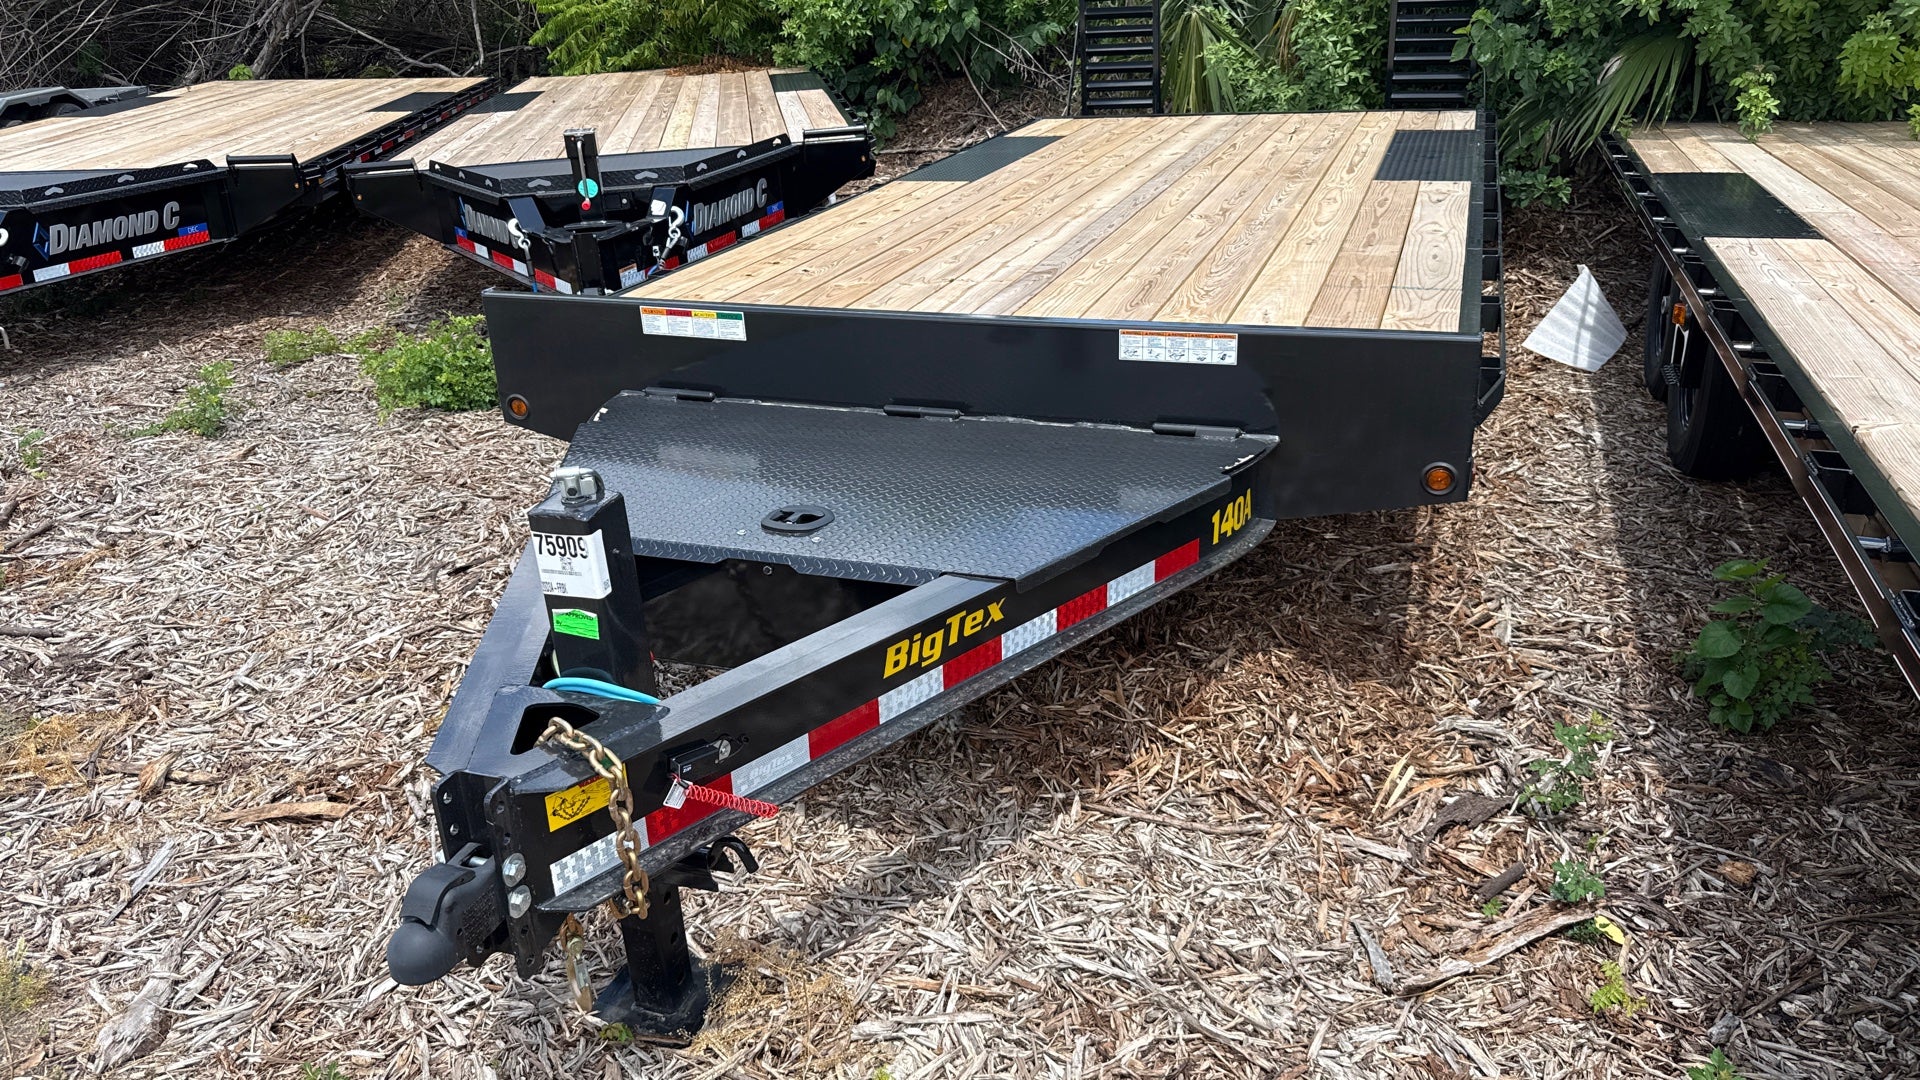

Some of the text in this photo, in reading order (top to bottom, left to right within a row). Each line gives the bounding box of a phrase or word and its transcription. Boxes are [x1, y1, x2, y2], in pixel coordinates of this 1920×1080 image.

[50, 201, 180, 255] DIAMOND C
[187, 225, 200, 234] DEC
[465, 203, 510, 245] DIAMOND
[693, 178, 768, 236] DIAMOND C
[533, 533, 589, 559] 75909
[883, 597, 1006, 679] BigTex
